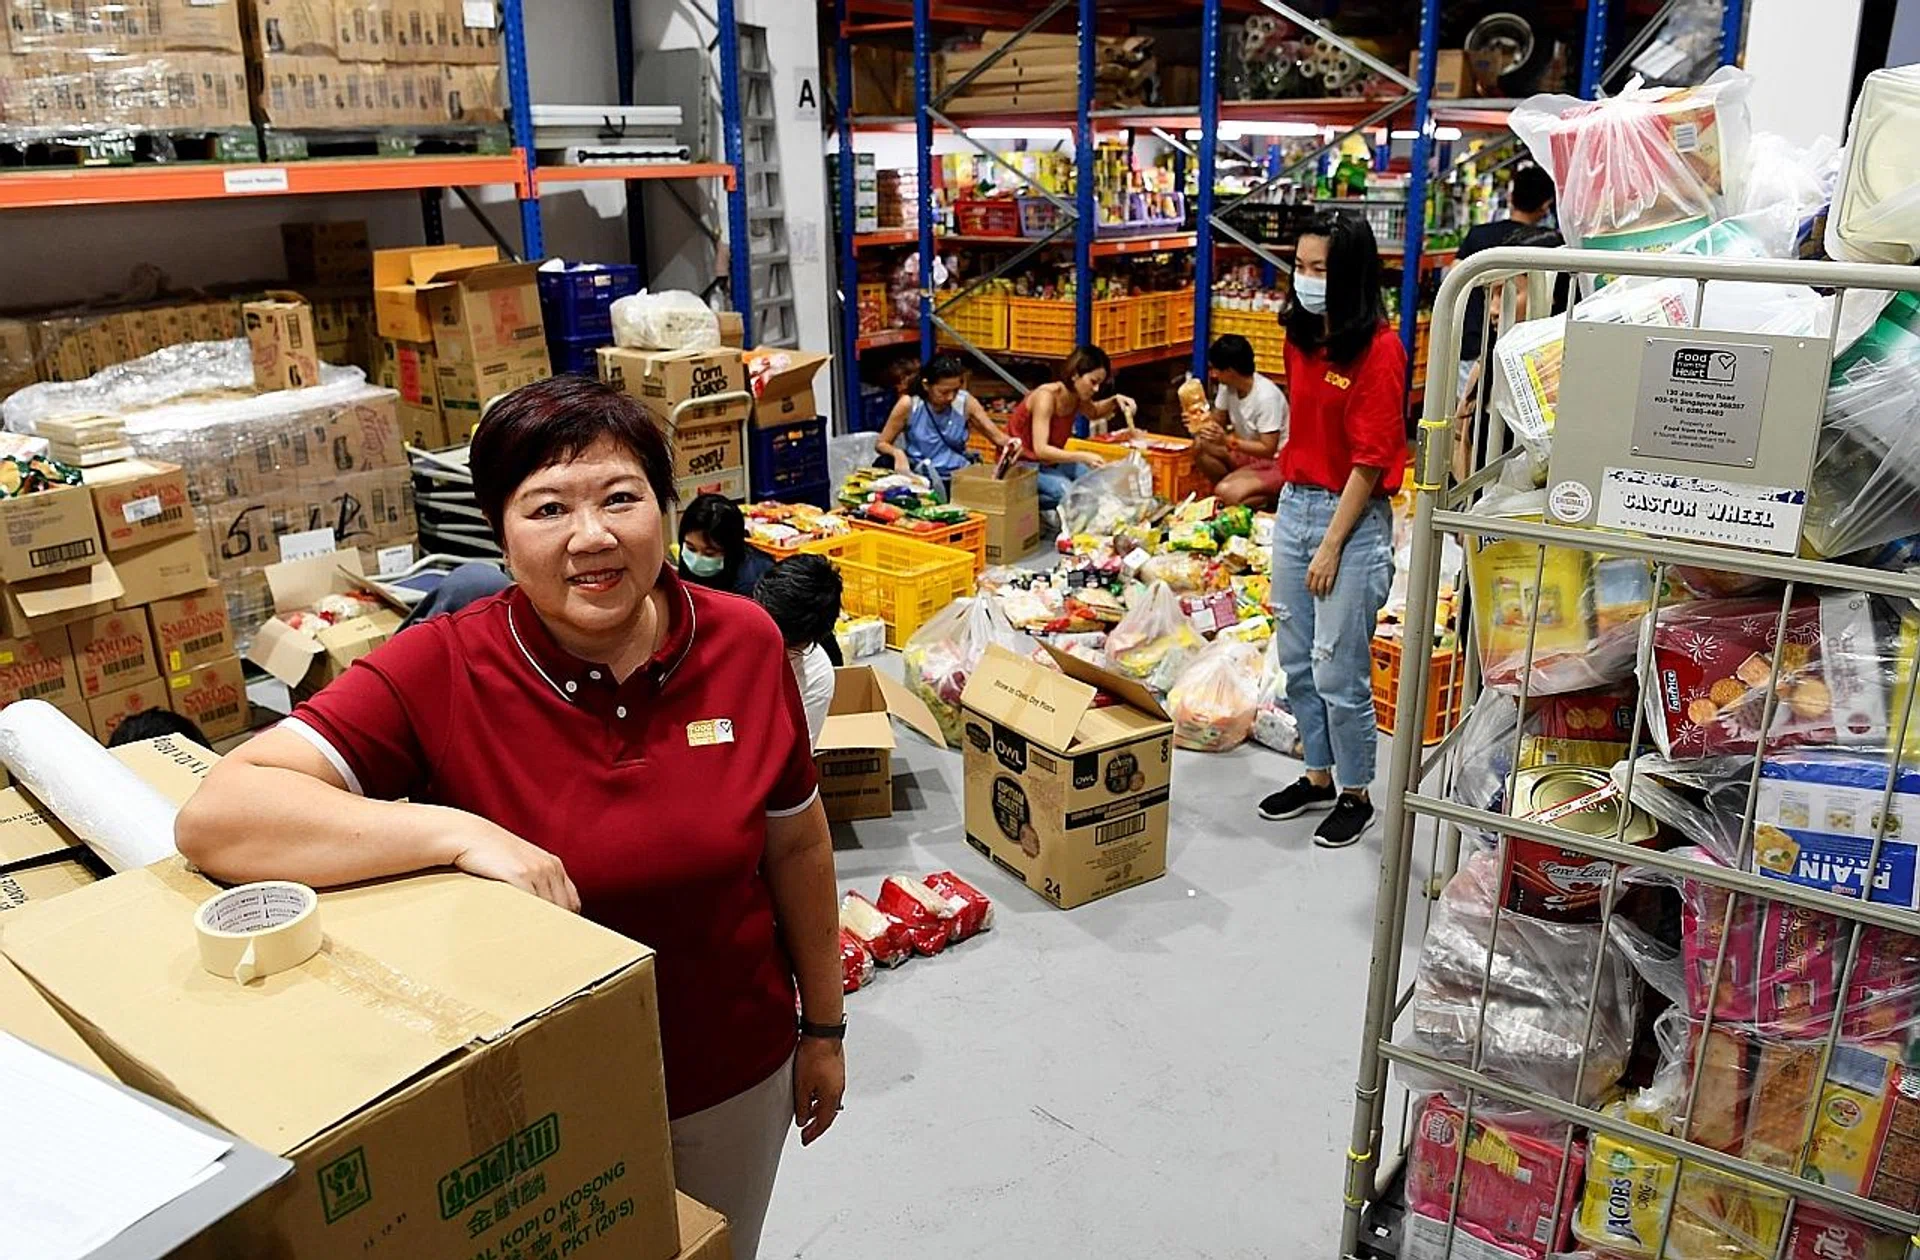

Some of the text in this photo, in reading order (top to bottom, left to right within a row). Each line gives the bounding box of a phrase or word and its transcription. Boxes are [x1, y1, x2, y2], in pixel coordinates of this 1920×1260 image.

[798, 79, 816, 108] A
[1676, 352, 1708, 363] Food
[692, 365, 723, 385] Corn
[1674, 367, 1706, 378] Heart
[1680, 398, 1717, 408] Singapore
[1623, 493, 1775, 529] CASTOR WHEEL
[1075, 774, 1096, 786] OWL
[1800, 851, 1893, 870] CACKERS
[1799, 860, 1891, 890] PLAIN
[1044, 876, 1062, 900] 24
[500, 1161, 626, 1251] KOPI O KOSONG
[561, 1226, 592, 1257] PKT
